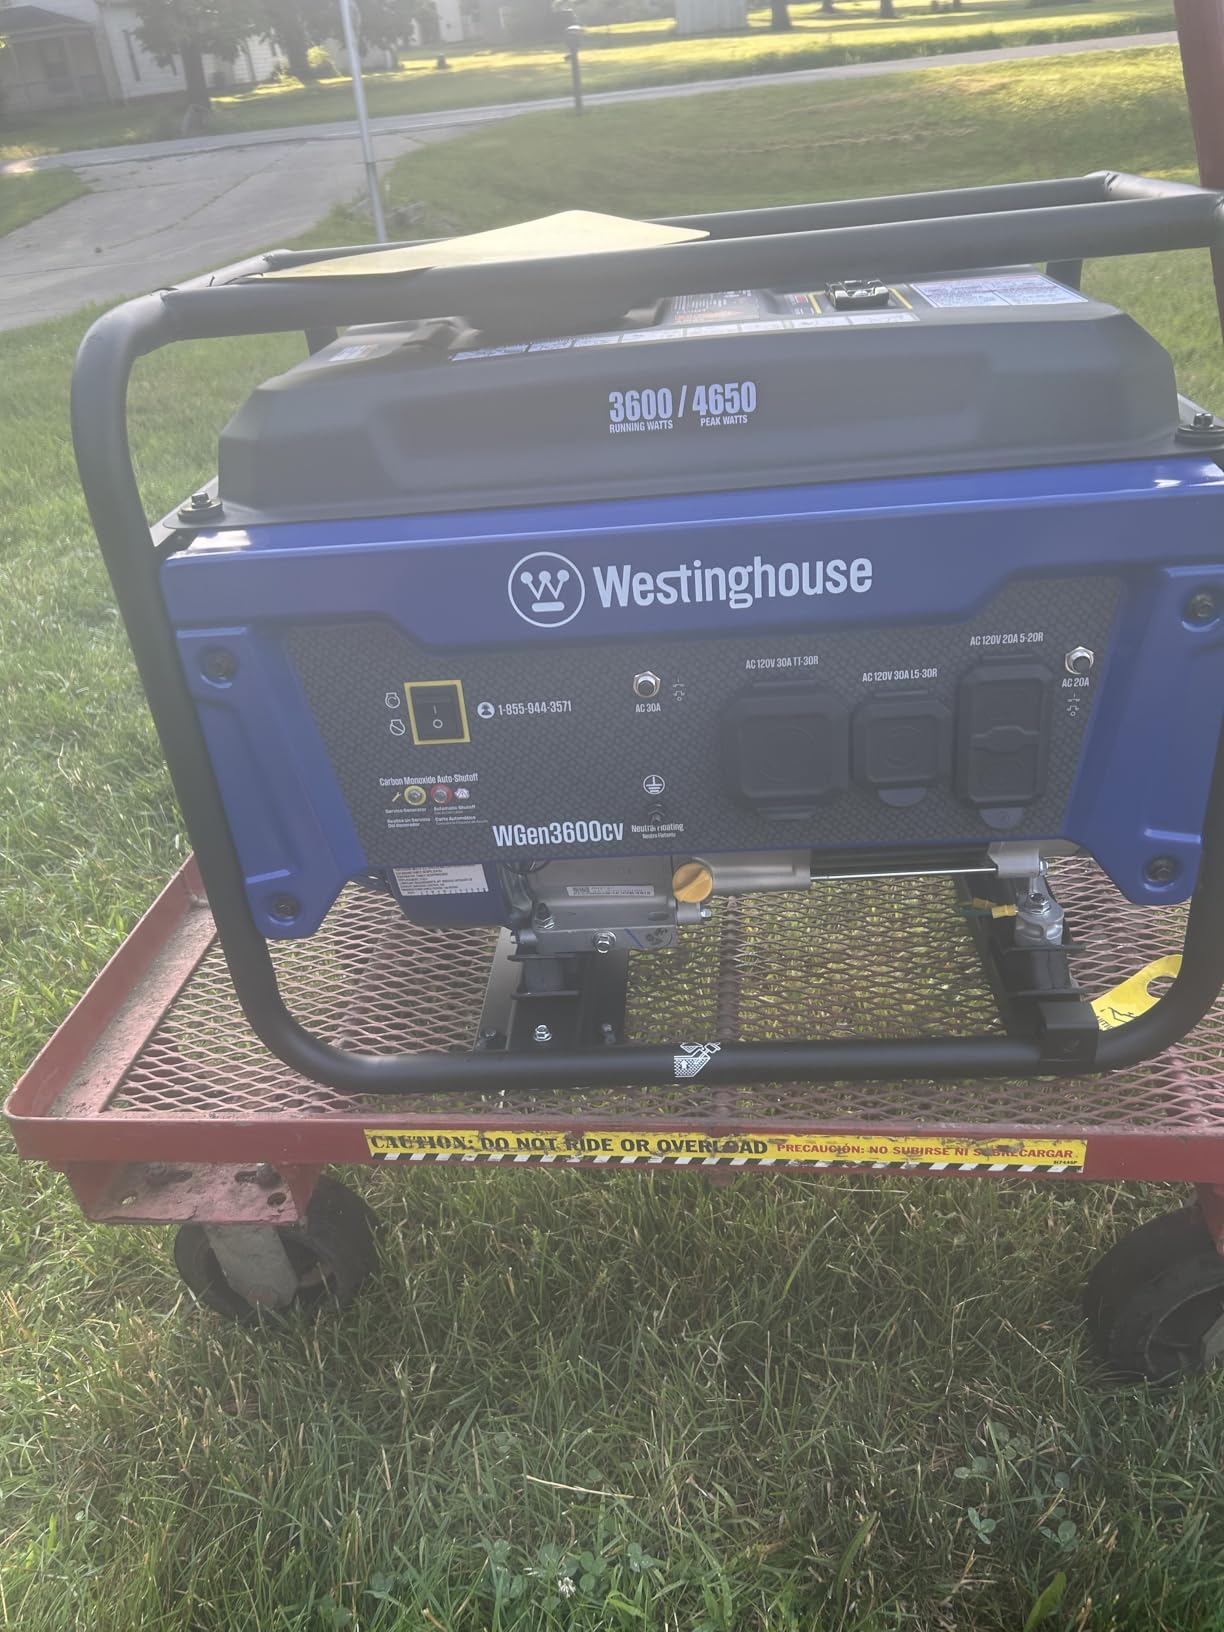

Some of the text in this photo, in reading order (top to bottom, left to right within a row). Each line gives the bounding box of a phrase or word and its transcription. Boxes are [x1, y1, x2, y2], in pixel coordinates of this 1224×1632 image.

[608, 387, 673, 423] 3600
[692, 381, 757, 416] 4650
[609, 419, 674, 434] RUNNING WATTS
[700, 414, 748, 427] PEAK WATTS
[592, 555, 873, 609] Westinghouse
[969, 632, 1044, 646] AC 120V 20A 5-20R
[745, 655, 819, 669] AC 120V 30A TT-30R
[862, 668, 938, 682] AC 120V 30A L5-30R
[1061, 677, 1090, 688] AC 20A
[498, 700, 572, 716] 1-855-944-3571
[635, 703, 661, 713] AC 30A
[379, 777, 404, 786] Carbon
[403, 775, 437, 785] Monoxide
[371, 1135, 475, 1150] CAUTION:
[480, 1137, 510, 1152] DO
[516, 1137, 557, 1151] NOT
[565, 1138, 614, 1152] RIDE
[620, 1138, 650, 1152] OR
[777, 1143, 1073, 1158] PRECAUCIÓN: NO SUBIRSE NI SBRECARGAR
